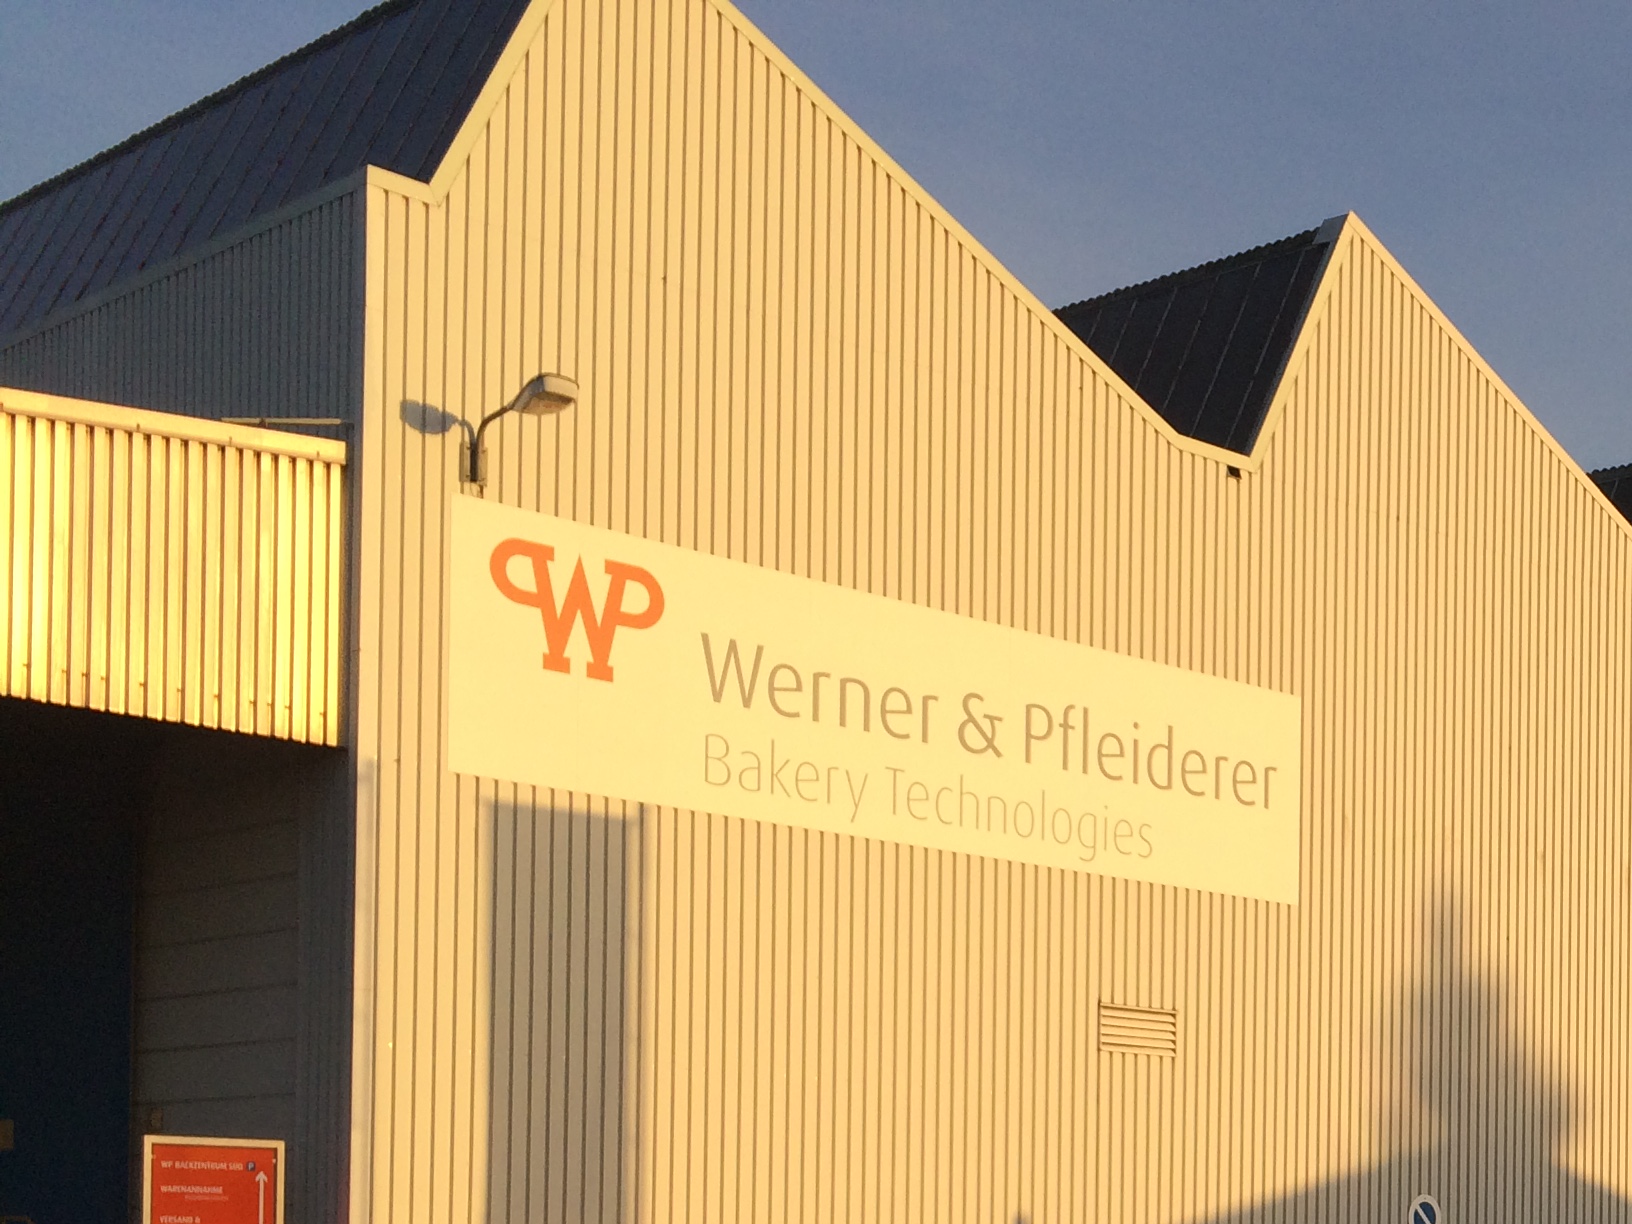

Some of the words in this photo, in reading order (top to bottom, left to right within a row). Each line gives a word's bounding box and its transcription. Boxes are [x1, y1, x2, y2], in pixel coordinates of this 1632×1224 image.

[700, 632, 939, 745] Werner
[957, 692, 1005, 759] &
[1025, 703, 1278, 810] Pfleiderer
[704, 733, 868, 823] Bakery
[886, 767, 1154, 863] Technologies
